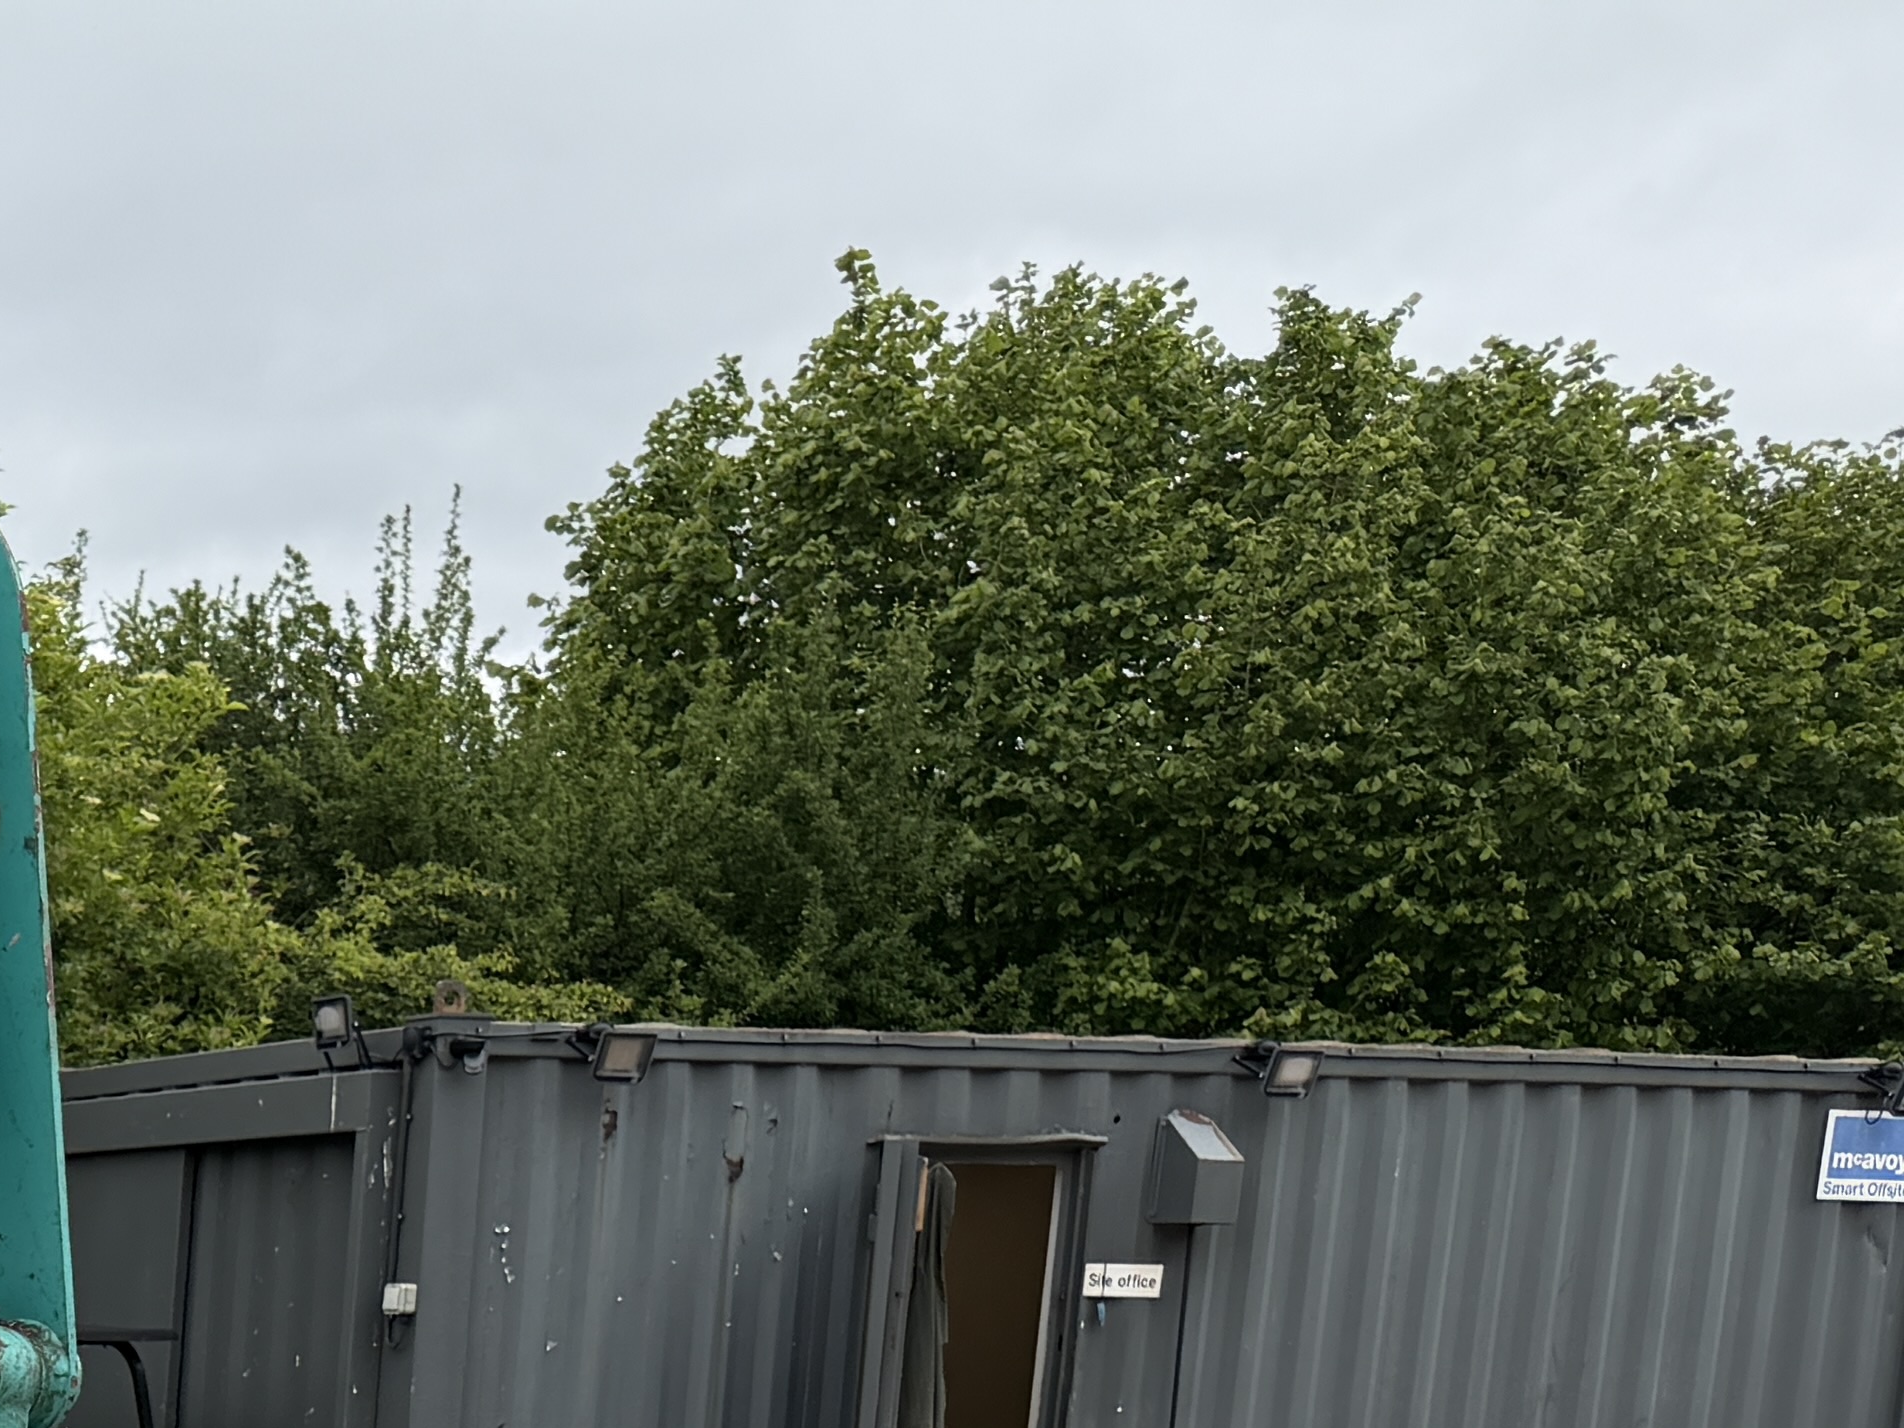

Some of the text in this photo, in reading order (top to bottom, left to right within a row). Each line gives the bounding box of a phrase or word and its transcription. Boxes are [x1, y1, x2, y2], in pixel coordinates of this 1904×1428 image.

[1823, 1181, 1904, 1198] Smart Offsit
[1117, 1273, 1157, 1289] office
